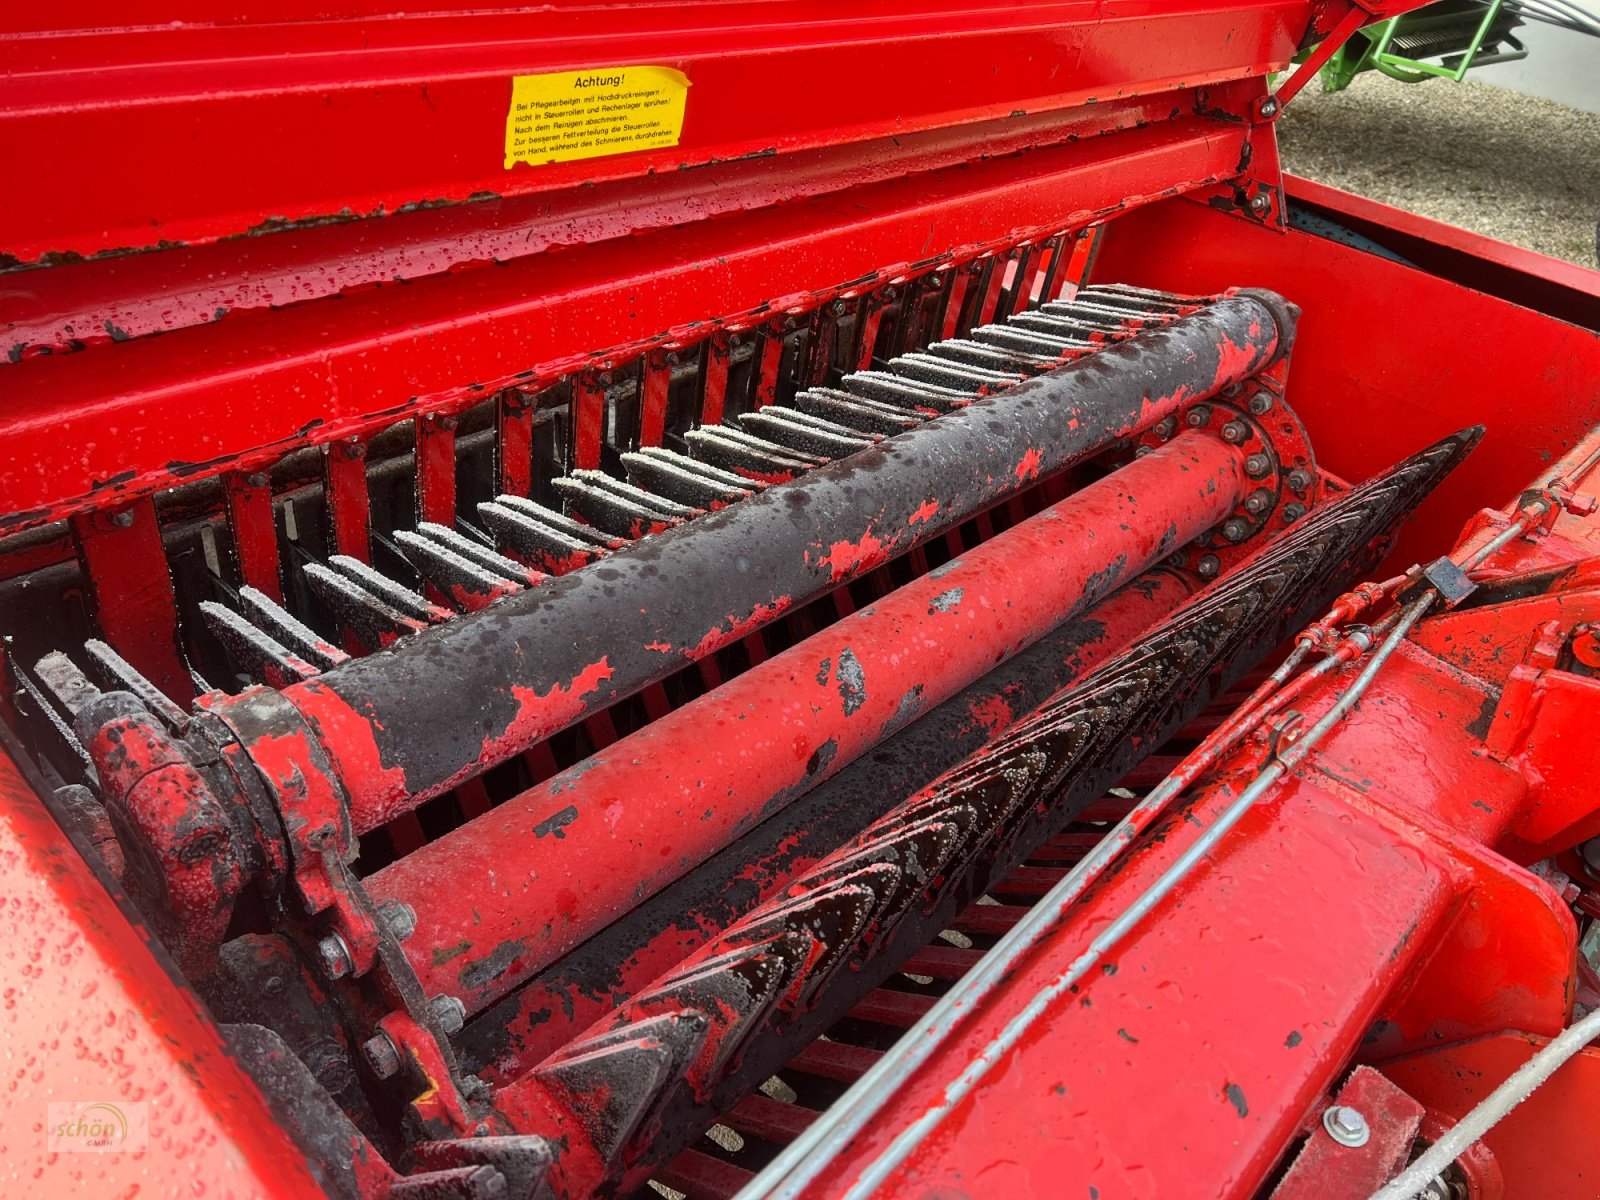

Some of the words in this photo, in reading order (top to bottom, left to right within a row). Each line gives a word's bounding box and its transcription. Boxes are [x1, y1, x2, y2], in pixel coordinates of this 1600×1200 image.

[575, 74, 624, 88] Achtung!
[515, 114, 532, 122] nicht
[544, 108, 584, 119] Steuerrollen
[587, 106, 599, 114] und
[602, 102, 641, 113] Rechenlager
[514, 138, 525, 146] Zur
[529, 133, 560, 144] besseren
[564, 128, 608, 139] Fettverteilung
[611, 125, 621, 133] die
[624, 121, 660, 131] Steuerrollen
[515, 126, 532, 134] Nach
[553, 120, 583, 130] Reinigen
[586, 114, 628, 125] abschmieren.
[549, 142, 578, 151] während
